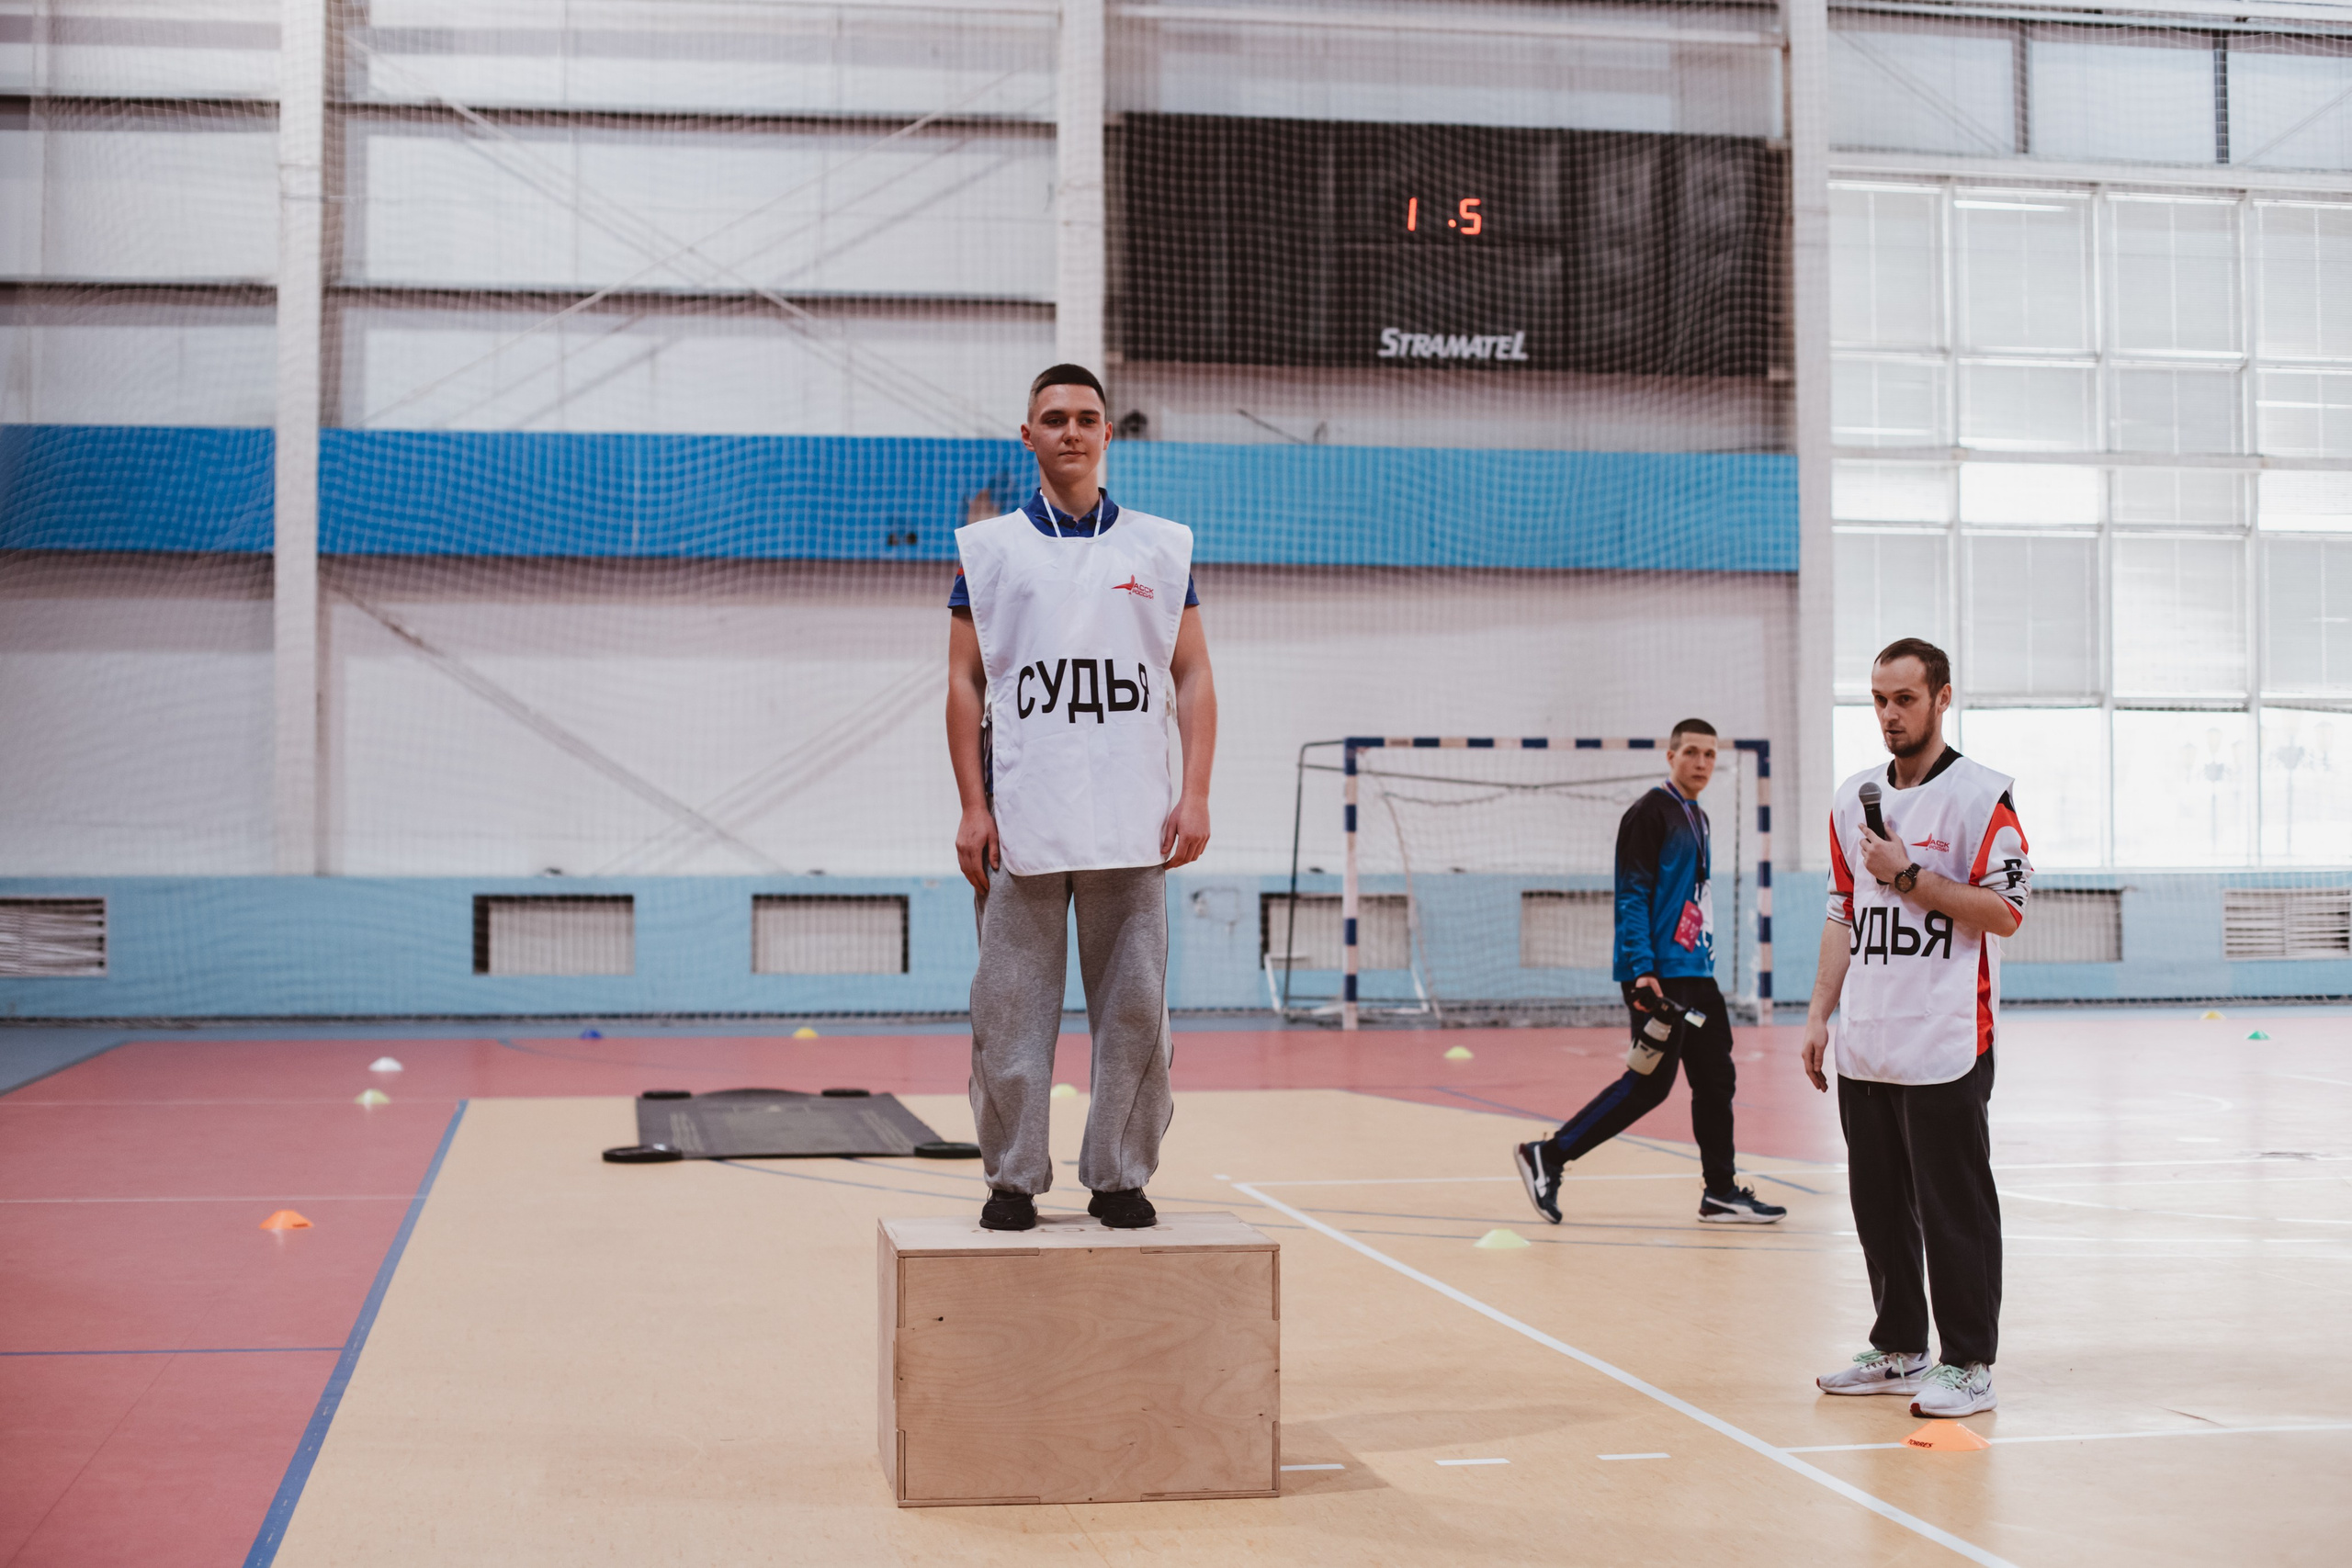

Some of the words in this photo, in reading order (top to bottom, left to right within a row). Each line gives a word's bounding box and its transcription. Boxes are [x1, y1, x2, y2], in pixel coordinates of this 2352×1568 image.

[1377, 327, 1529, 361] STRAMATEL
[1017, 658, 1150, 724] СУДЬЯ
[1850, 907, 1953, 965] УДЬЯ
